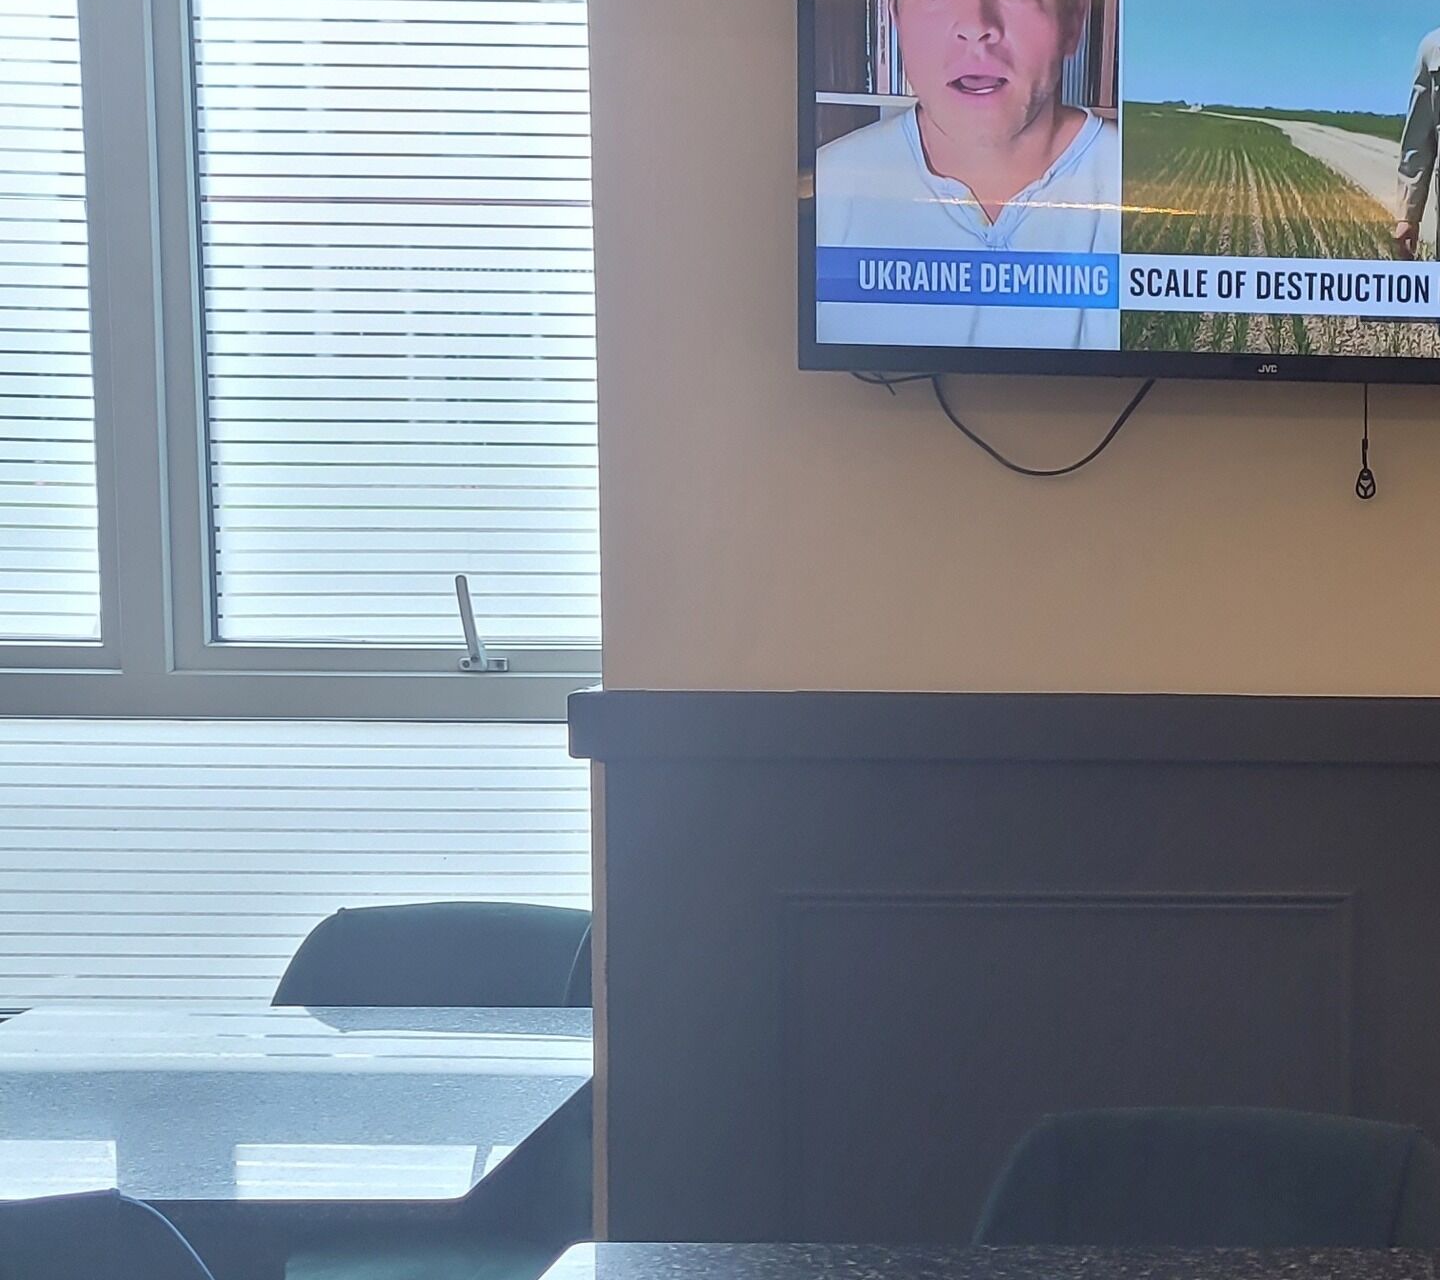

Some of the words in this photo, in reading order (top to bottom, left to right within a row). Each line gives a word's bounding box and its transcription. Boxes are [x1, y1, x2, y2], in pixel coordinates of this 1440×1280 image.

[858, 259, 972, 293] UKRAINE
[980, 262, 1109, 296] DEMINING
[1129, 267, 1208, 299] SCALE
[1217, 269, 1247, 300] OF
[1256, 271, 1430, 304] DESTRUCTION
[1257, 364, 1278, 374] JVC
